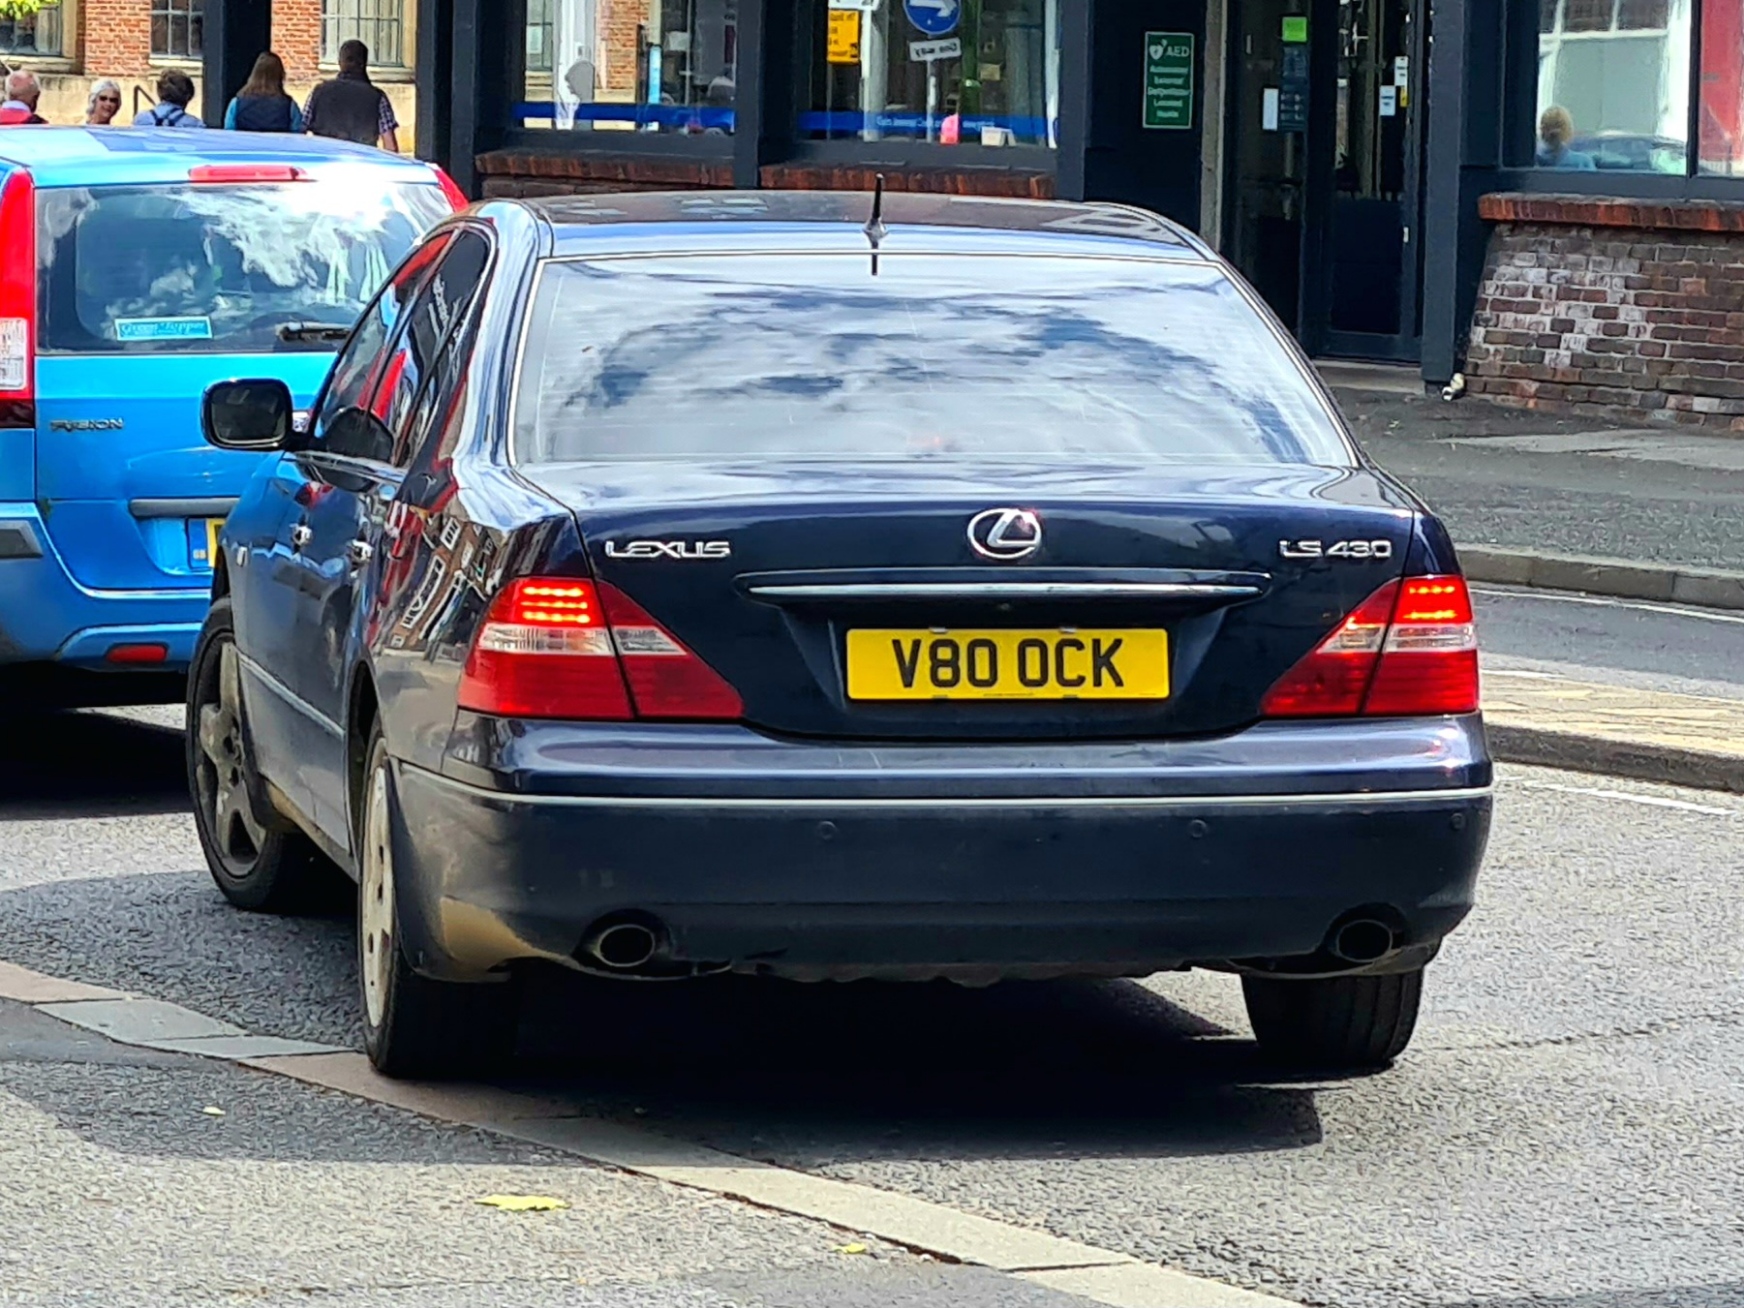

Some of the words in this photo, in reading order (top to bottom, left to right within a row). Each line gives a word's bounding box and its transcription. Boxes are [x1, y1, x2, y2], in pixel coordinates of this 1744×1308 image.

[1165, 45, 1190, 57] AED
[605, 541, 731, 558] LEXUS
[1279, 540, 1323, 557] LS
[1325, 540, 1392, 557] 430
[891, 638, 998, 689] V80
[1017, 638, 1125, 689] OCK
